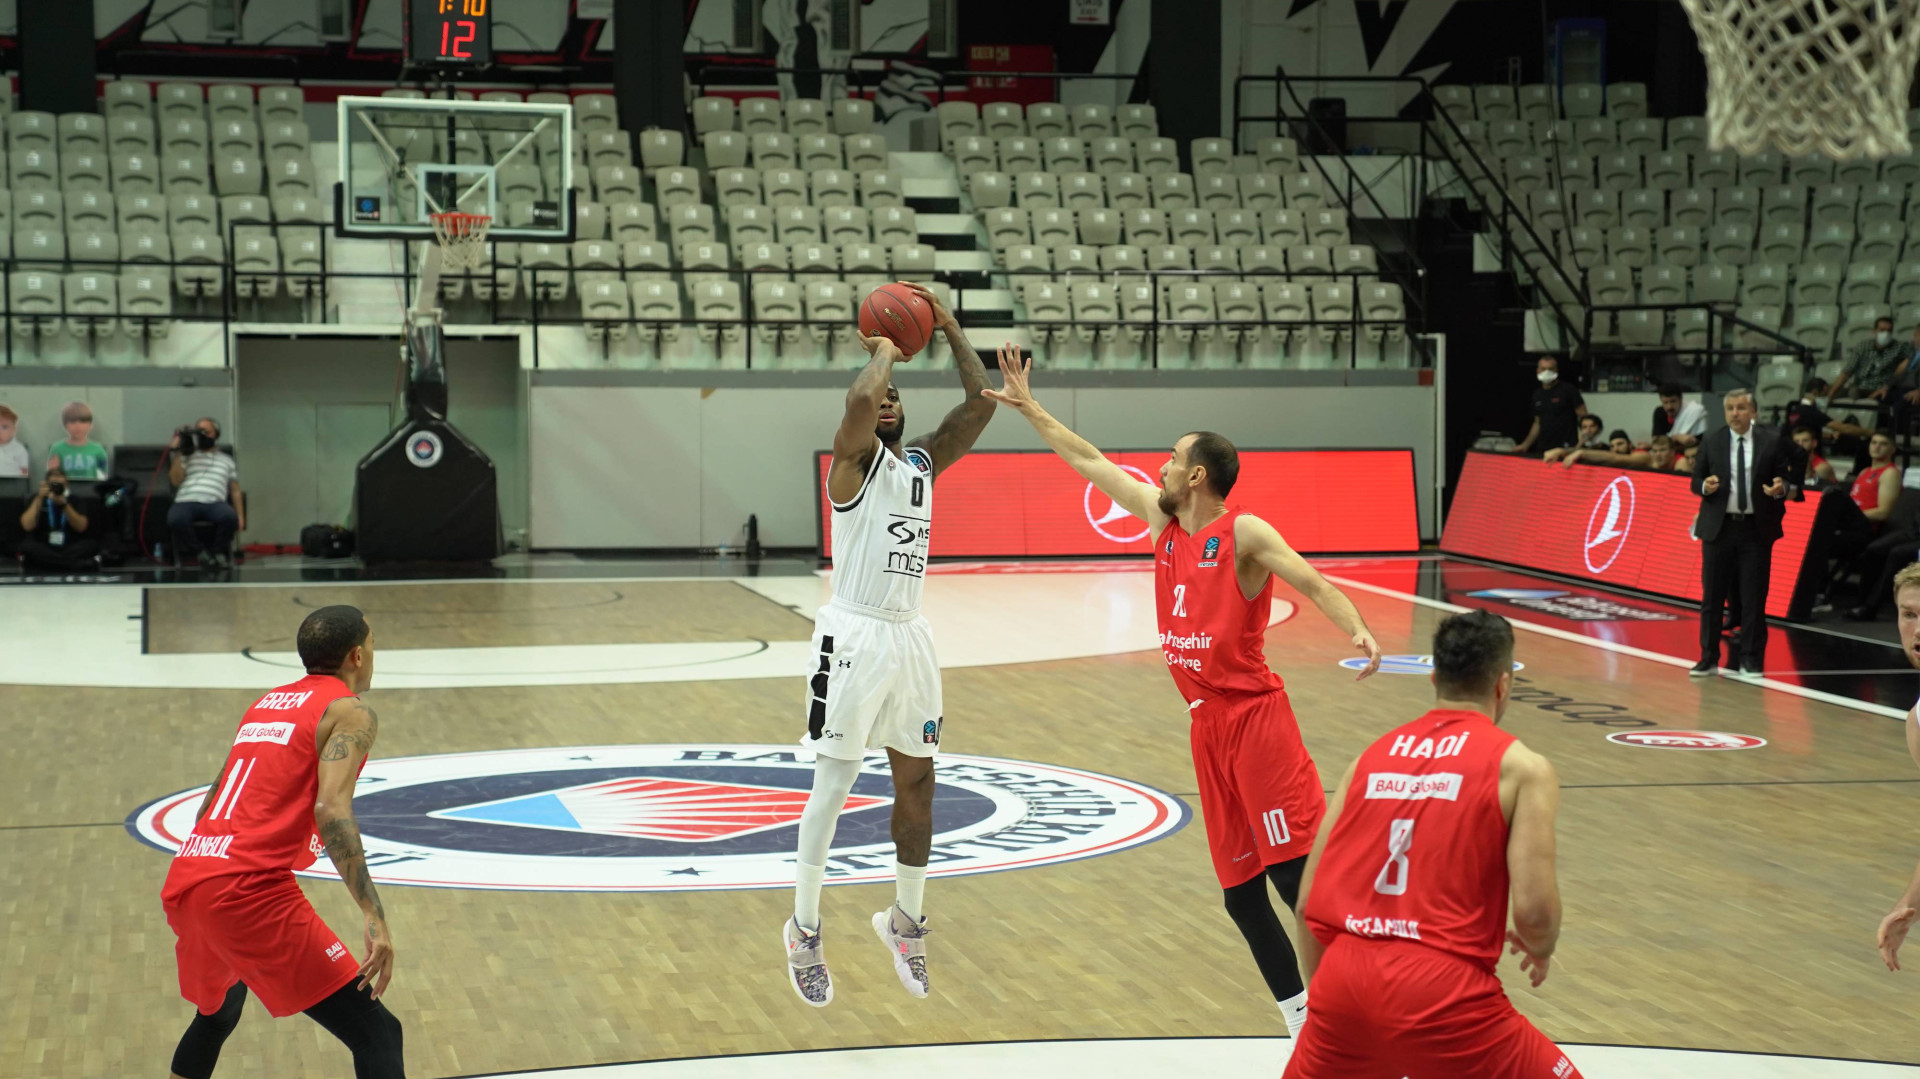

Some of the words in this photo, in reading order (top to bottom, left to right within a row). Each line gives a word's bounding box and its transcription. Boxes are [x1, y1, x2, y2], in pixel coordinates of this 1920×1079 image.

[440, 20, 476, 58] 12
[911, 476, 924, 508] 0
[887, 550, 925, 574] mts
[254, 690, 314, 710] GREEN
[256, 727, 287, 739] Global
[208, 757, 257, 820] 11
[1375, 780, 1406, 793] BAU
[1262, 808, 1291, 847] 10
[1374, 818, 1415, 896] 8
[325, 941, 343, 958] BAU
[1552, 1055, 1569, 1077] BAU
